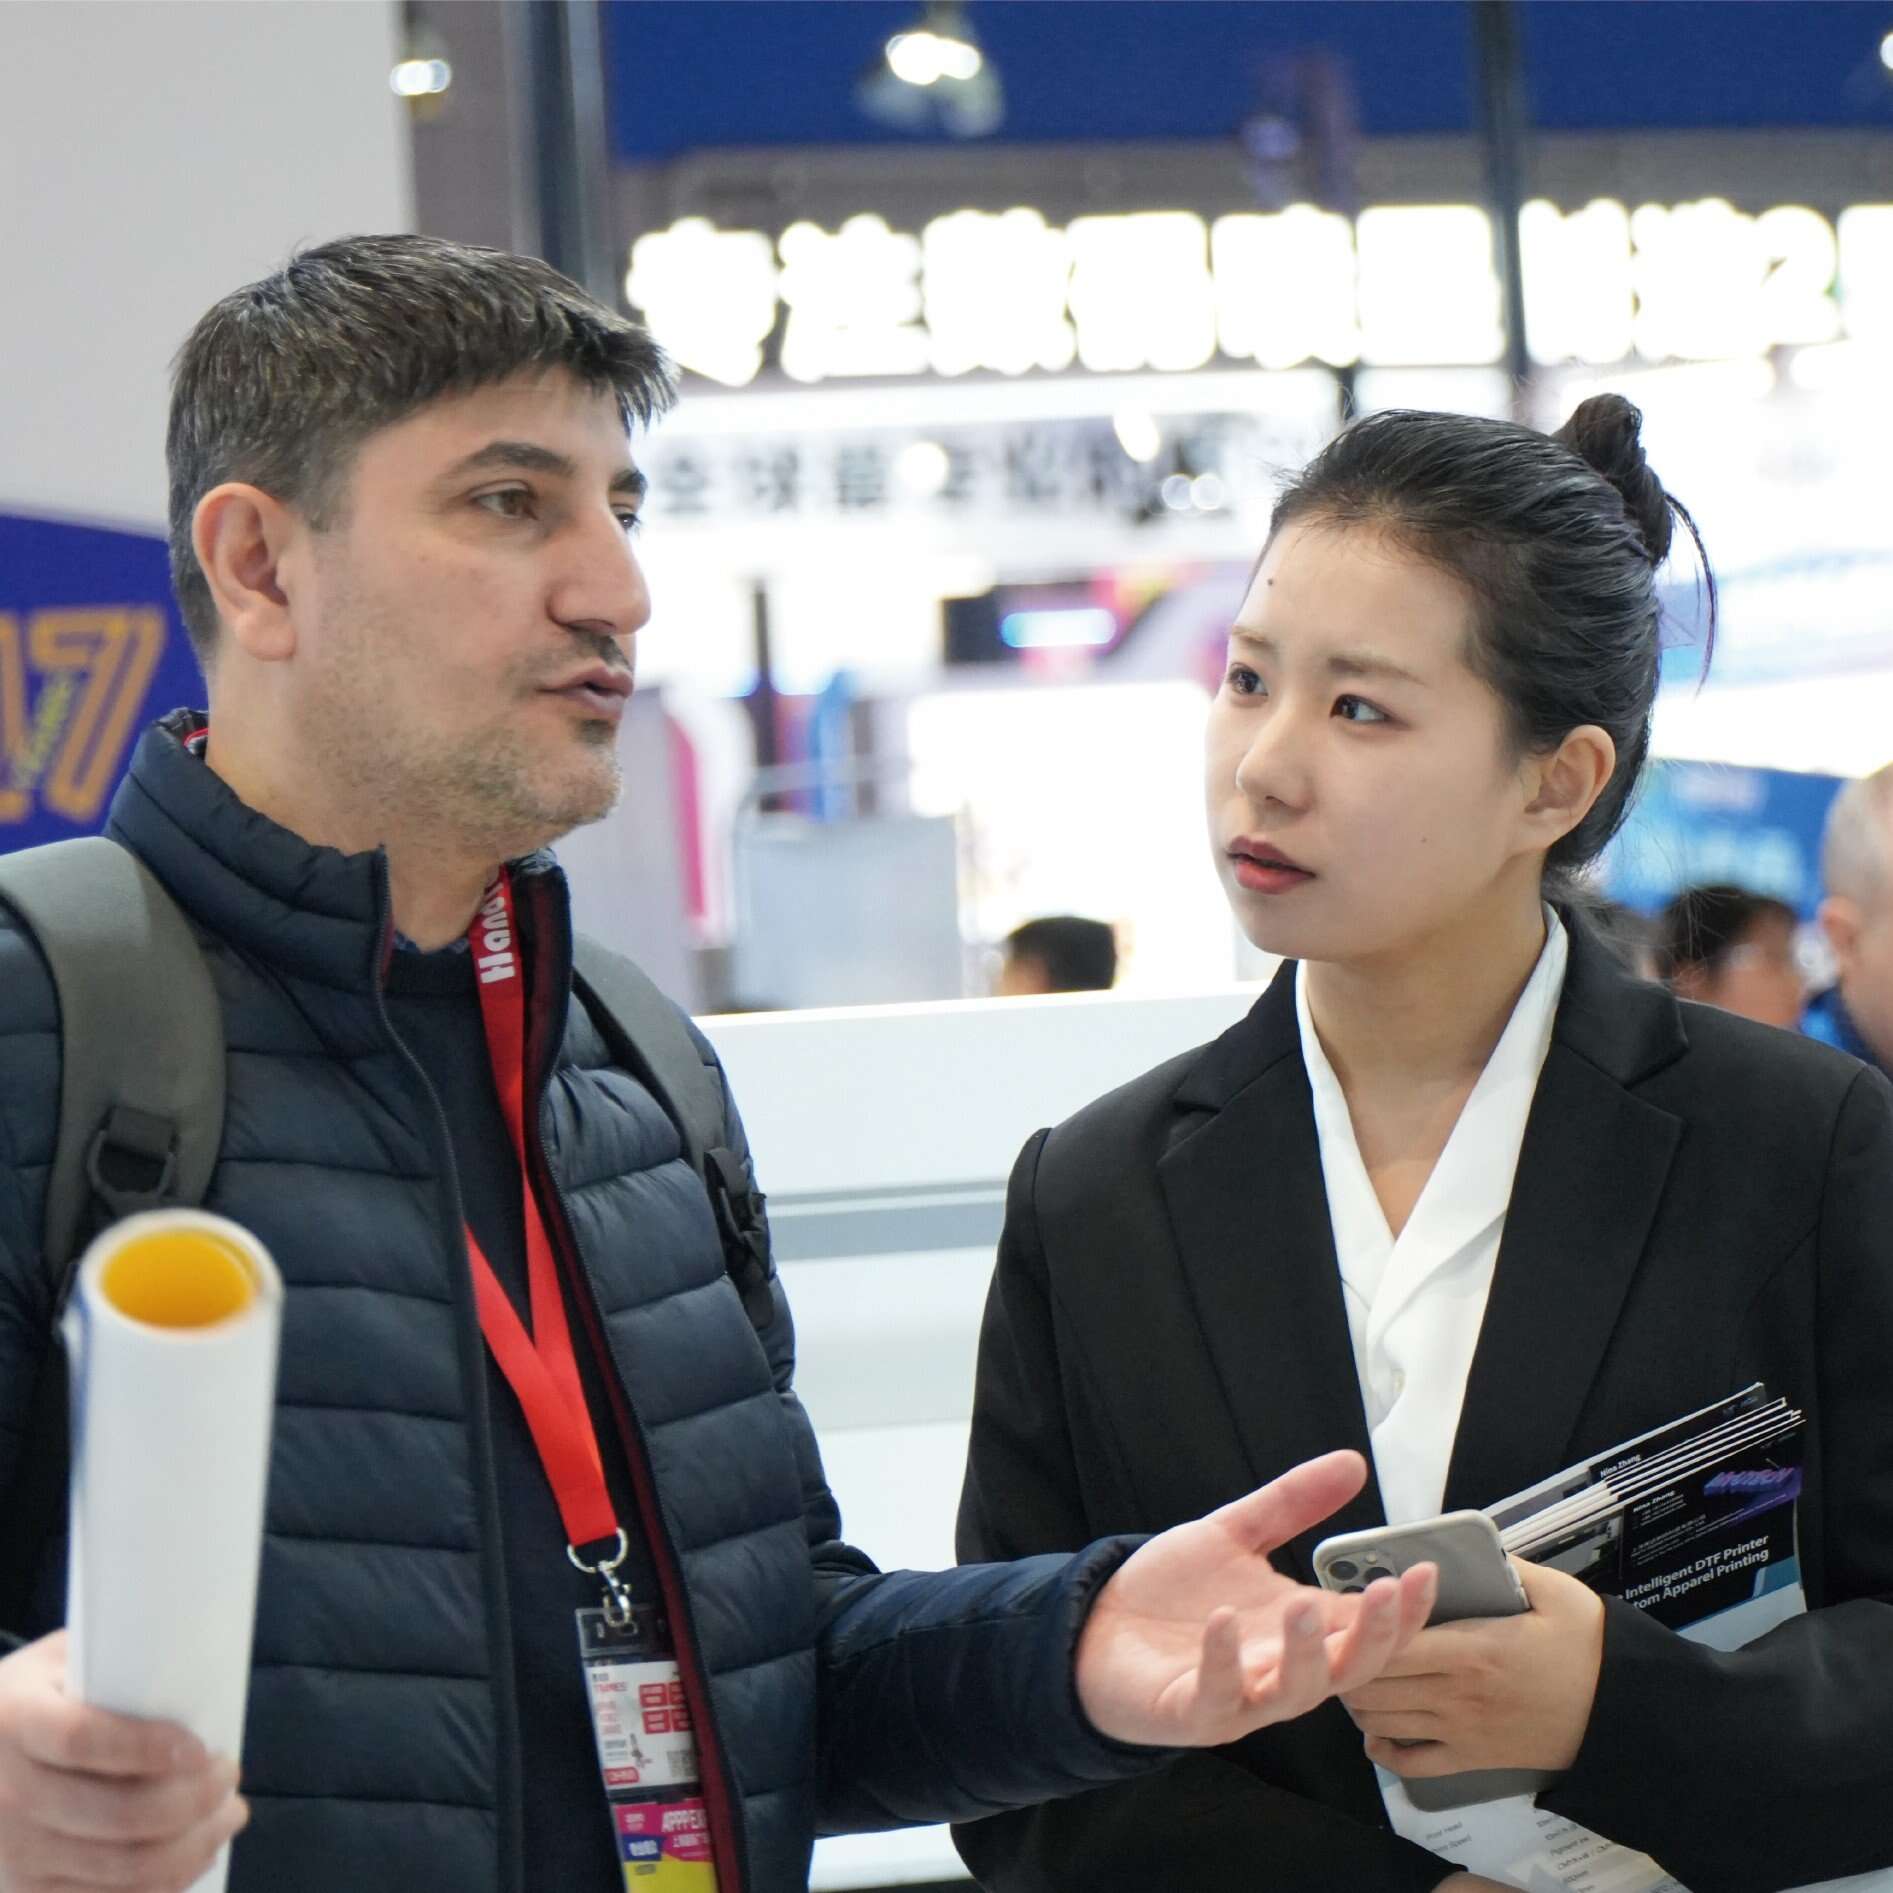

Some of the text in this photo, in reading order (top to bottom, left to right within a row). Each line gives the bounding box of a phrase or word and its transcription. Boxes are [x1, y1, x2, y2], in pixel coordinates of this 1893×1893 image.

[1618, 1454, 1642, 1468] Zhang
[1625, 1564, 1693, 1600] Intelligent
[1695, 1552, 1722, 1572] DTF
[1723, 1535, 1769, 1561] Printer
[1662, 1568, 1715, 1600] Apparel
[1716, 1549, 1769, 1577] Printing
